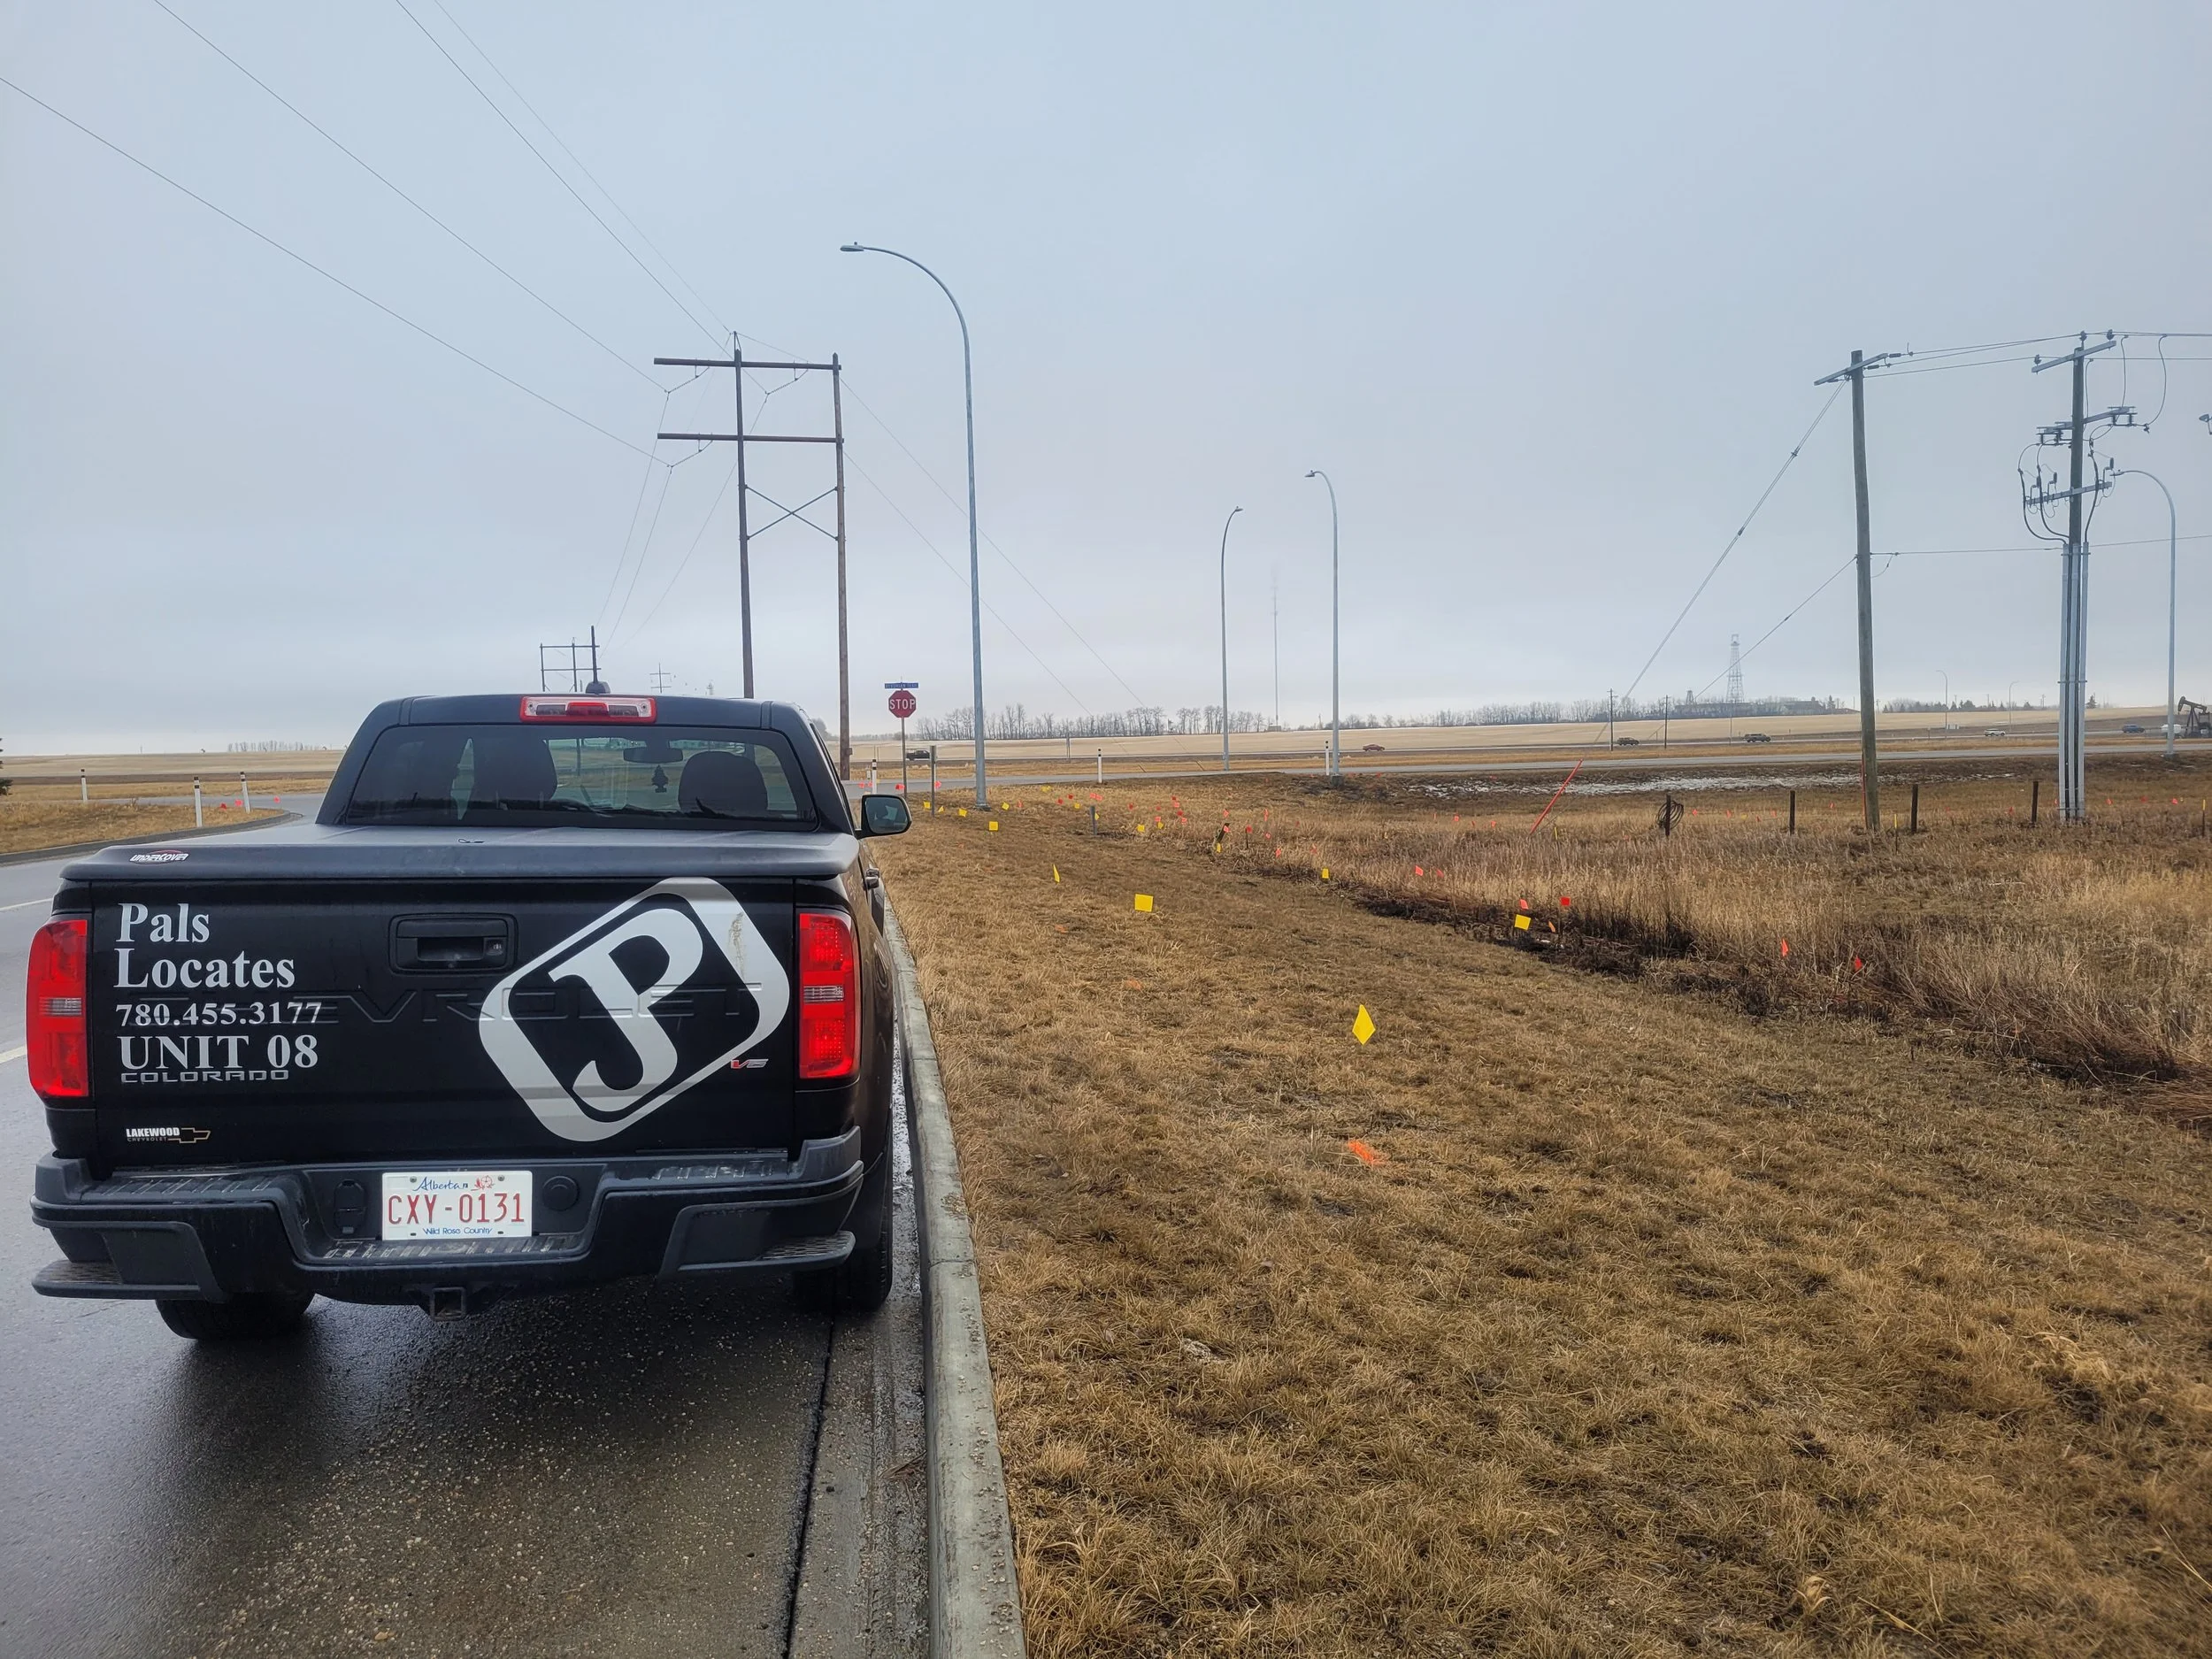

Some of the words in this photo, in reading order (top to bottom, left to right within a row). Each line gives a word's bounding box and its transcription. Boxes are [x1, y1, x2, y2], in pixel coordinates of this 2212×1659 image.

[889, 698, 916, 710] STOP
[115, 902, 211, 943] Pals
[113, 948, 296, 988] Locates
[115, 1001, 322, 1026] 780.455.3177
[117, 1035, 249, 1070] UNIT
[267, 1034, 319, 1069] 08
[120, 1070, 289, 1084] COLORADO
[126, 1127, 180, 1138] LAKEWOOD
[412, 1176, 463, 1192] Alberta
[388, 1193, 525, 1225] CXY-0131
